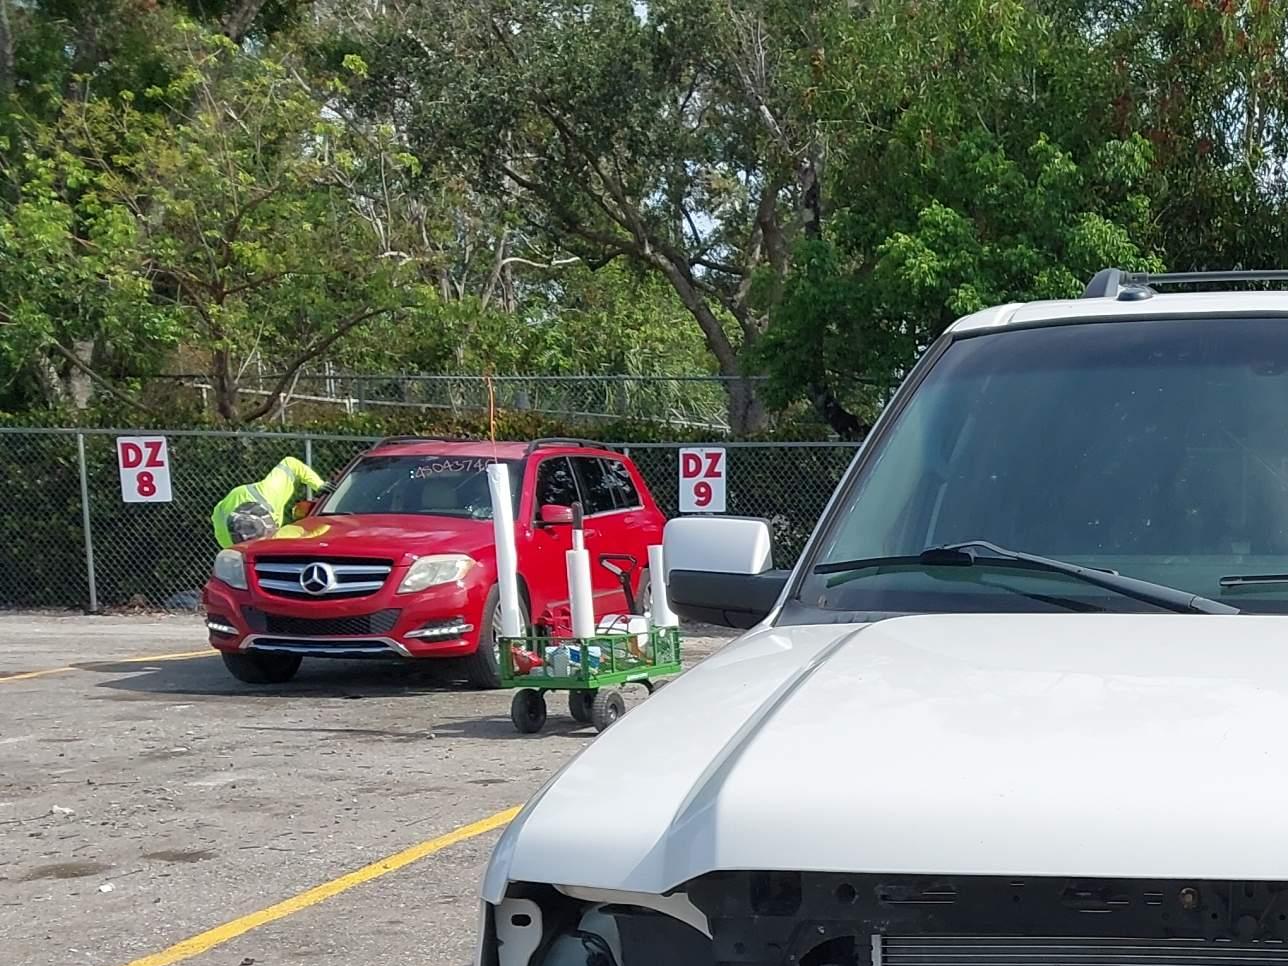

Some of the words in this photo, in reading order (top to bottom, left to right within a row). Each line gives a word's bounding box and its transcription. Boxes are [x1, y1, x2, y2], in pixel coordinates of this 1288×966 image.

[121, 441, 165, 469] DZ
[682, 452, 723, 478] DZ
[136, 471, 156, 497] 8
[694, 481, 713, 507] 9
